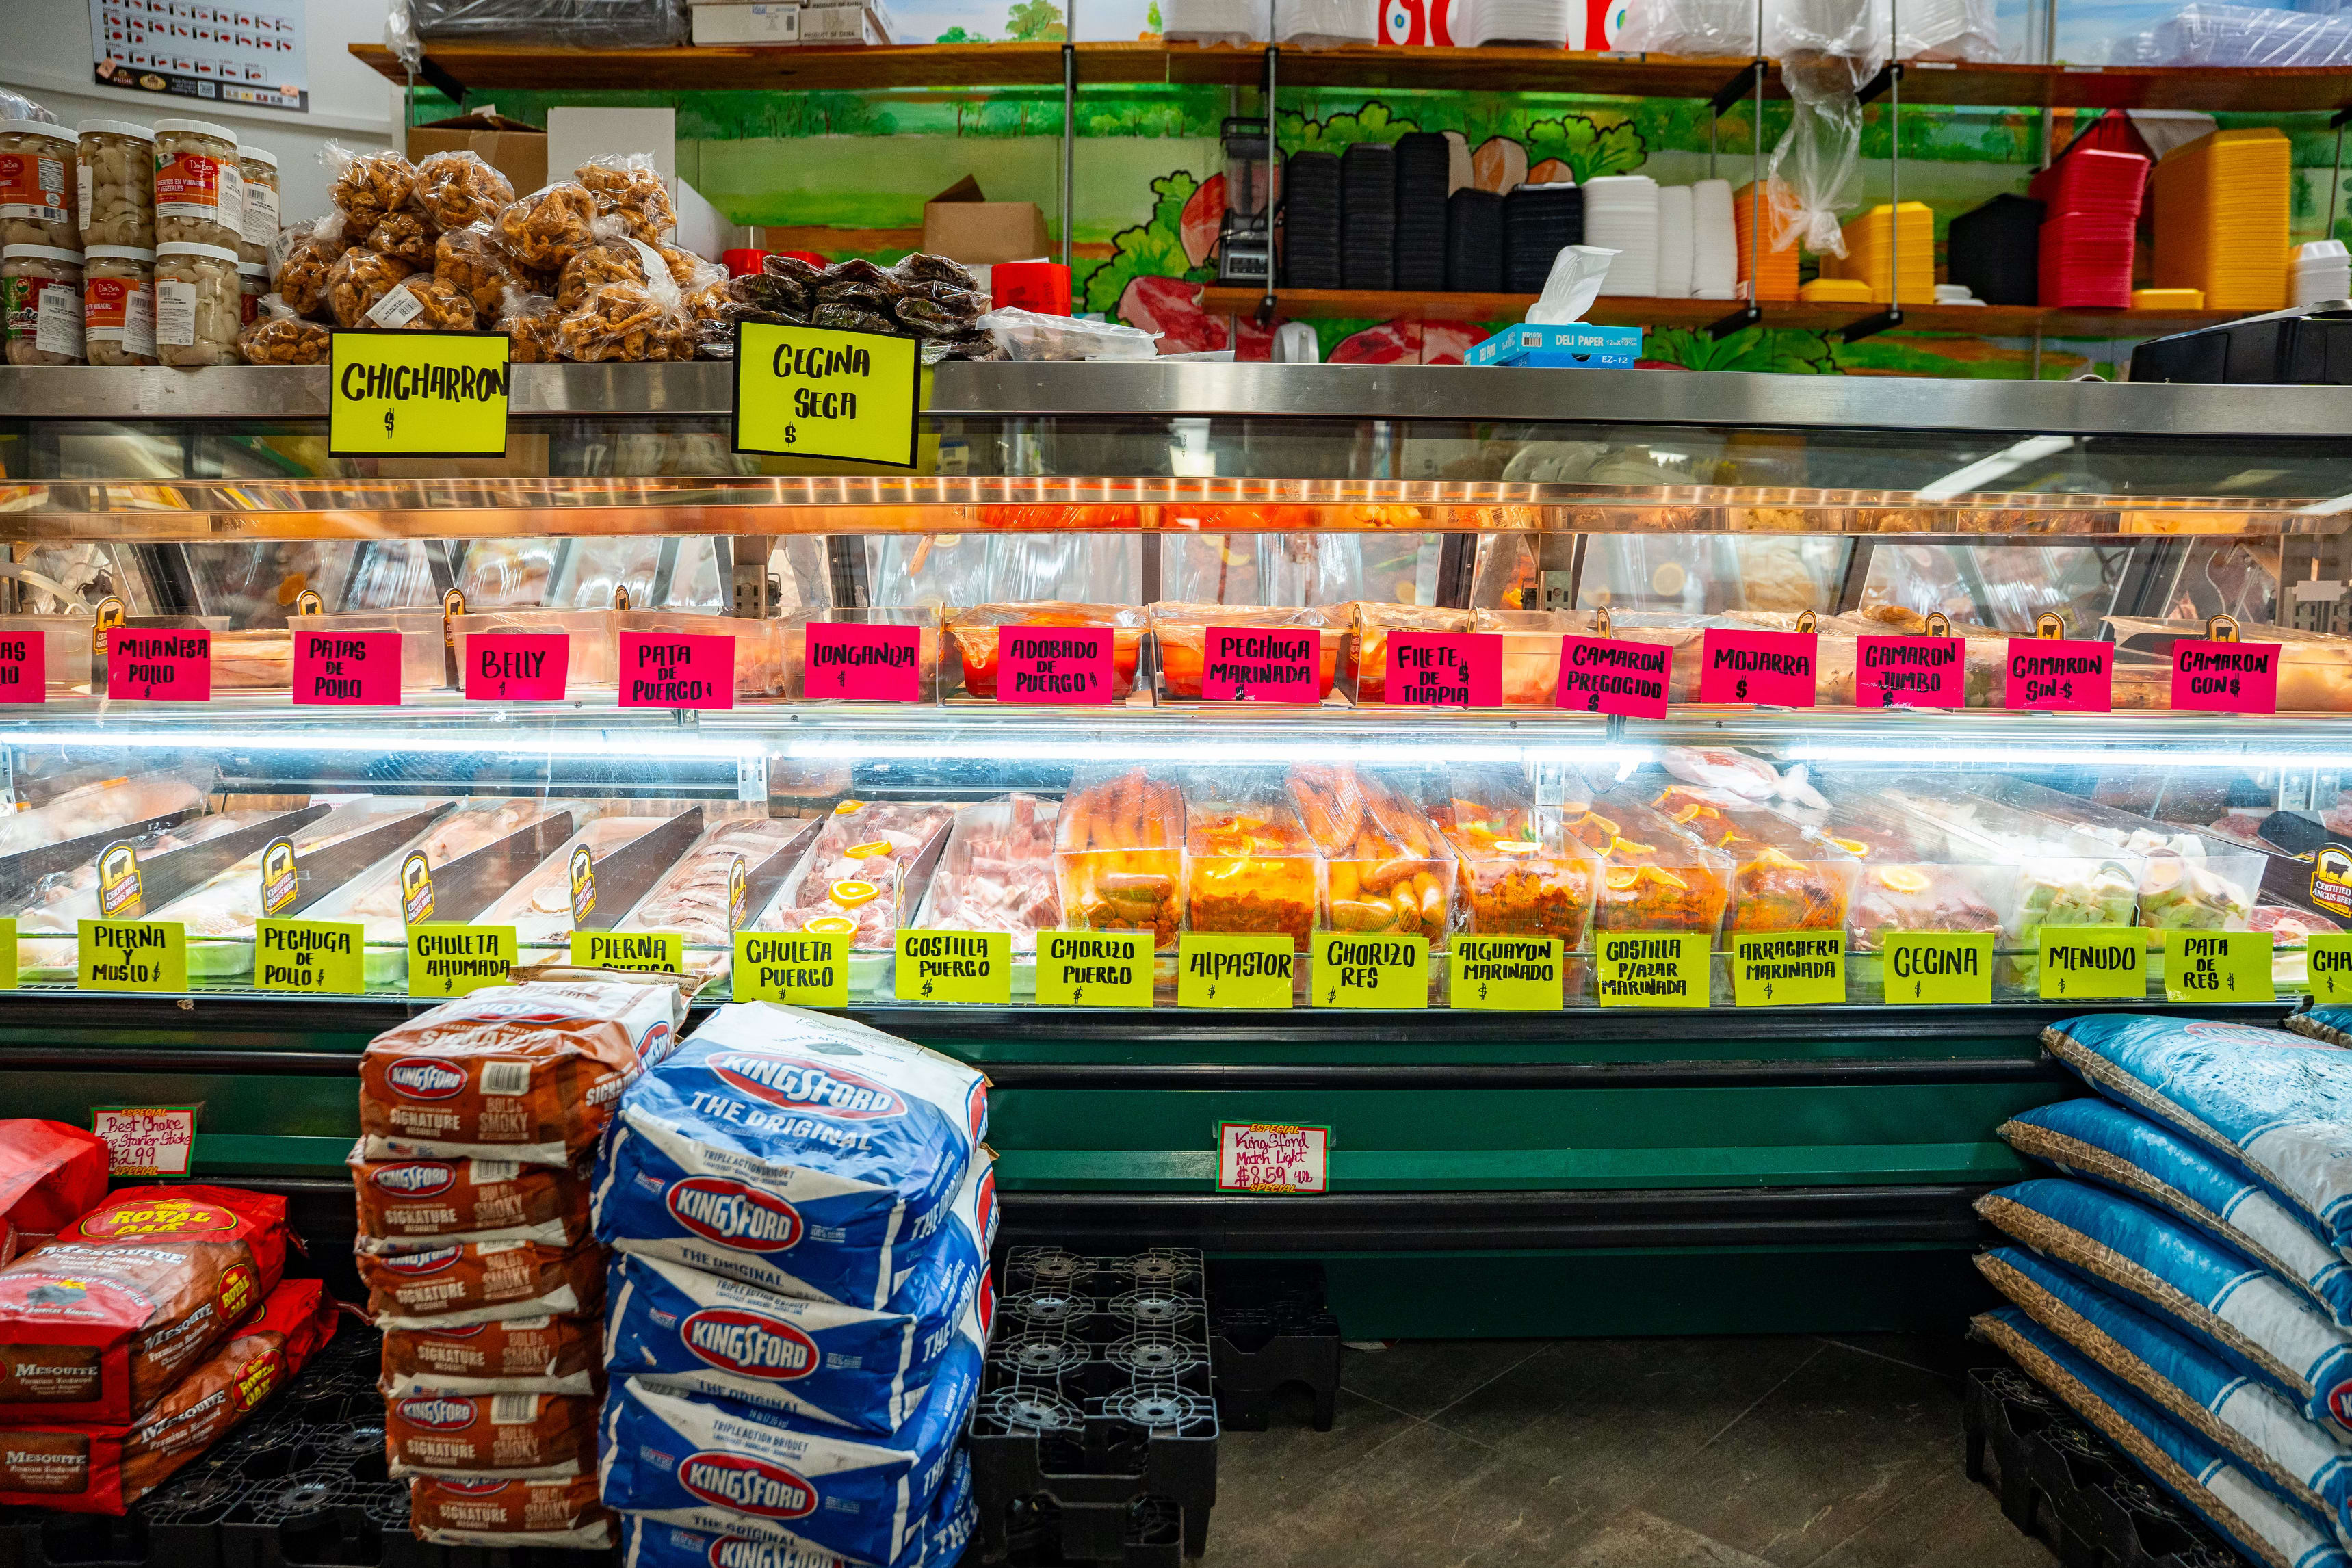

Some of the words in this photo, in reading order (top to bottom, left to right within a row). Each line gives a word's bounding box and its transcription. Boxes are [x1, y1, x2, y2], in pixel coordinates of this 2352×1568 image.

[1556, 335, 1573, 345] DELI
[1578, 335, 1603, 347] PAPER
[773, 344, 870, 378] CECINA
[341, 362, 509, 402] CHICHARRON
[794, 388, 856, 419] SECA
[385, 408, 394, 439] $
[785, 421, 796, 447] $
[118, 636, 207, 659] MILANESA
[310, 638, 366, 661] PATAS
[639, 644, 690, 668] PATA
[1010, 640, 1097, 659] ADOBADO
[1221, 635, 1310, 662] PECHUGA
[1398, 646, 1457, 668] FILETE
[1865, 642, 1956, 668] CAMARON
[326, 661, 344, 675] DE
[482, 651, 545, 678] BELLY
[1037, 660, 1056, 673] DE
[1573, 644, 1664, 674] CAMARON
[1714, 648, 1809, 676] MOJARRA
[2013, 655, 2102, 678] CAMARON
[2180, 651, 2269, 674] CAMARON
[129, 665, 174, 684] POLLO
[658, 667, 677, 681] DE
[1016, 672, 1086, 694] PUERCO
[1209, 663, 1311, 684] MARINADA
[1420, 670, 1439, 686] DE
[1879, 671, 1940, 692] JUMBO
[315, 677, 361, 698] POLLO
[633, 680, 701, 702] PUERCO
[1403, 685, 1468, 705] TILAPIA
[1567, 670, 1661, 699] PRECOCIDO
[1736, 675, 1747, 701] $
[2026, 681, 2057, 701] SIN
[2191, 677, 2227, 694] CON
[107, 876, 135, 900] CERTIFIED
[267, 872, 291, 897] CERTIFIED
[2316, 881, 2351, 896] CERTIFIED
[106, 893, 125, 909] ANGUS
[267, 891, 283, 907] ANGUS
[2312, 888, 2336, 900] ANGUS
[2337, 896, 2352, 905] BEEF
[94, 925, 165, 948] PIERNA
[265, 928, 350, 954] PECHUGA
[417, 935, 499, 956] CHULETA
[906, 936, 988, 957] COSTILLA
[122, 949, 133, 965] Y
[591, 937, 666, 961] PIERNA
[746, 939, 831, 963] CHULETA
[1051, 939, 1135, 960] CHORIZO
[1327, 941, 1415, 967] CHORIZO
[1459, 941, 1552, 962] ALGUAYON
[1606, 940, 1681, 961] COSTILLA
[1740, 940, 1838, 960] ARRACHERA
[2184, 938, 2227, 957] PATA
[296, 953, 313, 967] DE
[427, 958, 510, 976] AHUMADA
[919, 960, 990, 977] PUERCO
[1894, 946, 1978, 978] CECINA
[2049, 946, 2136, 971] MENUDO
[2196, 958, 2215, 971] DE
[92, 964, 148, 982] MUSLO
[265, 965, 311, 986] POLLO
[760, 966, 833, 987] PUERCO
[1063, 965, 1132, 984] PUERCO
[1341, 967, 1378, 988] RES
[1463, 964, 1553, 981] MARINADO
[1746, 961, 1835, 980] MARINADA
[2184, 971, 2219, 990] RES
[2227, 972, 2234, 991] $
[1602, 979, 1686, 996] MARINADA
[1764, 982, 1773, 999] $
[1915, 980, 1922, 998] $
[2058, 978, 2065, 993] $
[392, 1064, 461, 1091] KINGSFORD
[721, 1056, 893, 1112] KINGSFORD
[120, 1108, 167, 1116] ESPECIAL
[389, 1108, 460, 1131] SIGNATURE
[480, 1112, 528, 1132] SMOKY
[691, 1093, 746, 1123] THE
[745, 1110, 873, 1151] ORIGINAL
[107, 1116, 140, 1133] Best
[143, 1116, 184, 1132] Choice
[1249, 1124, 1299, 1134] ESPECIAL
[118, 1130, 159, 1147] Starter
[160, 1132, 191, 1145] Sticks
[109, 1145, 155, 1168] $2.99
[703, 1149, 733, 1162] TRIPLE
[733, 1157, 761, 1173] ACTION
[1236, 1151, 1270, 1166] Match
[1276, 1149, 1307, 1168] Light
[114, 1166, 159, 1175] SPECIAL
[377, 1164, 448, 1190] KINGSFORD
[1235, 1166, 1286, 1187] $8.59
[1294, 1171, 1313, 1184] 4lb
[1249, 1183, 1296, 1192] SPECIAL
[384, 1208, 457, 1225] SIGNATURE
[473, 1194, 523, 1219] SMOKY
[677, 1187, 792, 1241] KINGSFORD
[108, 1210, 212, 1225] ROYAL
[910, 1202, 939, 1241] THE
[114, 1223, 186, 1236] OAK
[32, 1246, 187, 1264] MESQUITE
[681, 1246, 710, 1264] THE
[714, 1259, 783, 1287] ORIGINAL
[483, 1268, 530, 1292] SMOKY
[717, 1280, 744, 1296] TRIPLE
[395, 1281, 466, 1303] SIGNATURE
[142, 1303, 213, 1354] MESQUITE
[692, 1322, 807, 1369] KINGSFORD
[924, 1322, 948, 1362] THE
[417, 1346, 485, 1367] SIGNATURE
[15, 1363, 99, 1377] MESQUITE
[239, 1364, 275, 1396] ROYAL
[246, 1378, 270, 1406] OAK
[142, 1390, 226, 1444] MESQUITE
[404, 1400, 471, 1423] KINGSFORD
[712, 1420, 741, 1436] TRIPLE
[742, 1425, 772, 1443] ACTION
[773, 1435, 809, 1452] BRIQUET
[5, 1451, 86, 1465] MESQUITE
[407, 1439, 475, 1459] SIGNATURE
[493, 1438, 538, 1458] SMOKY
[924, 1447, 948, 1495] THE
[689, 1463, 806, 1510] KINGSFORD
[439, 1505, 507, 1523] SIGNATURE
